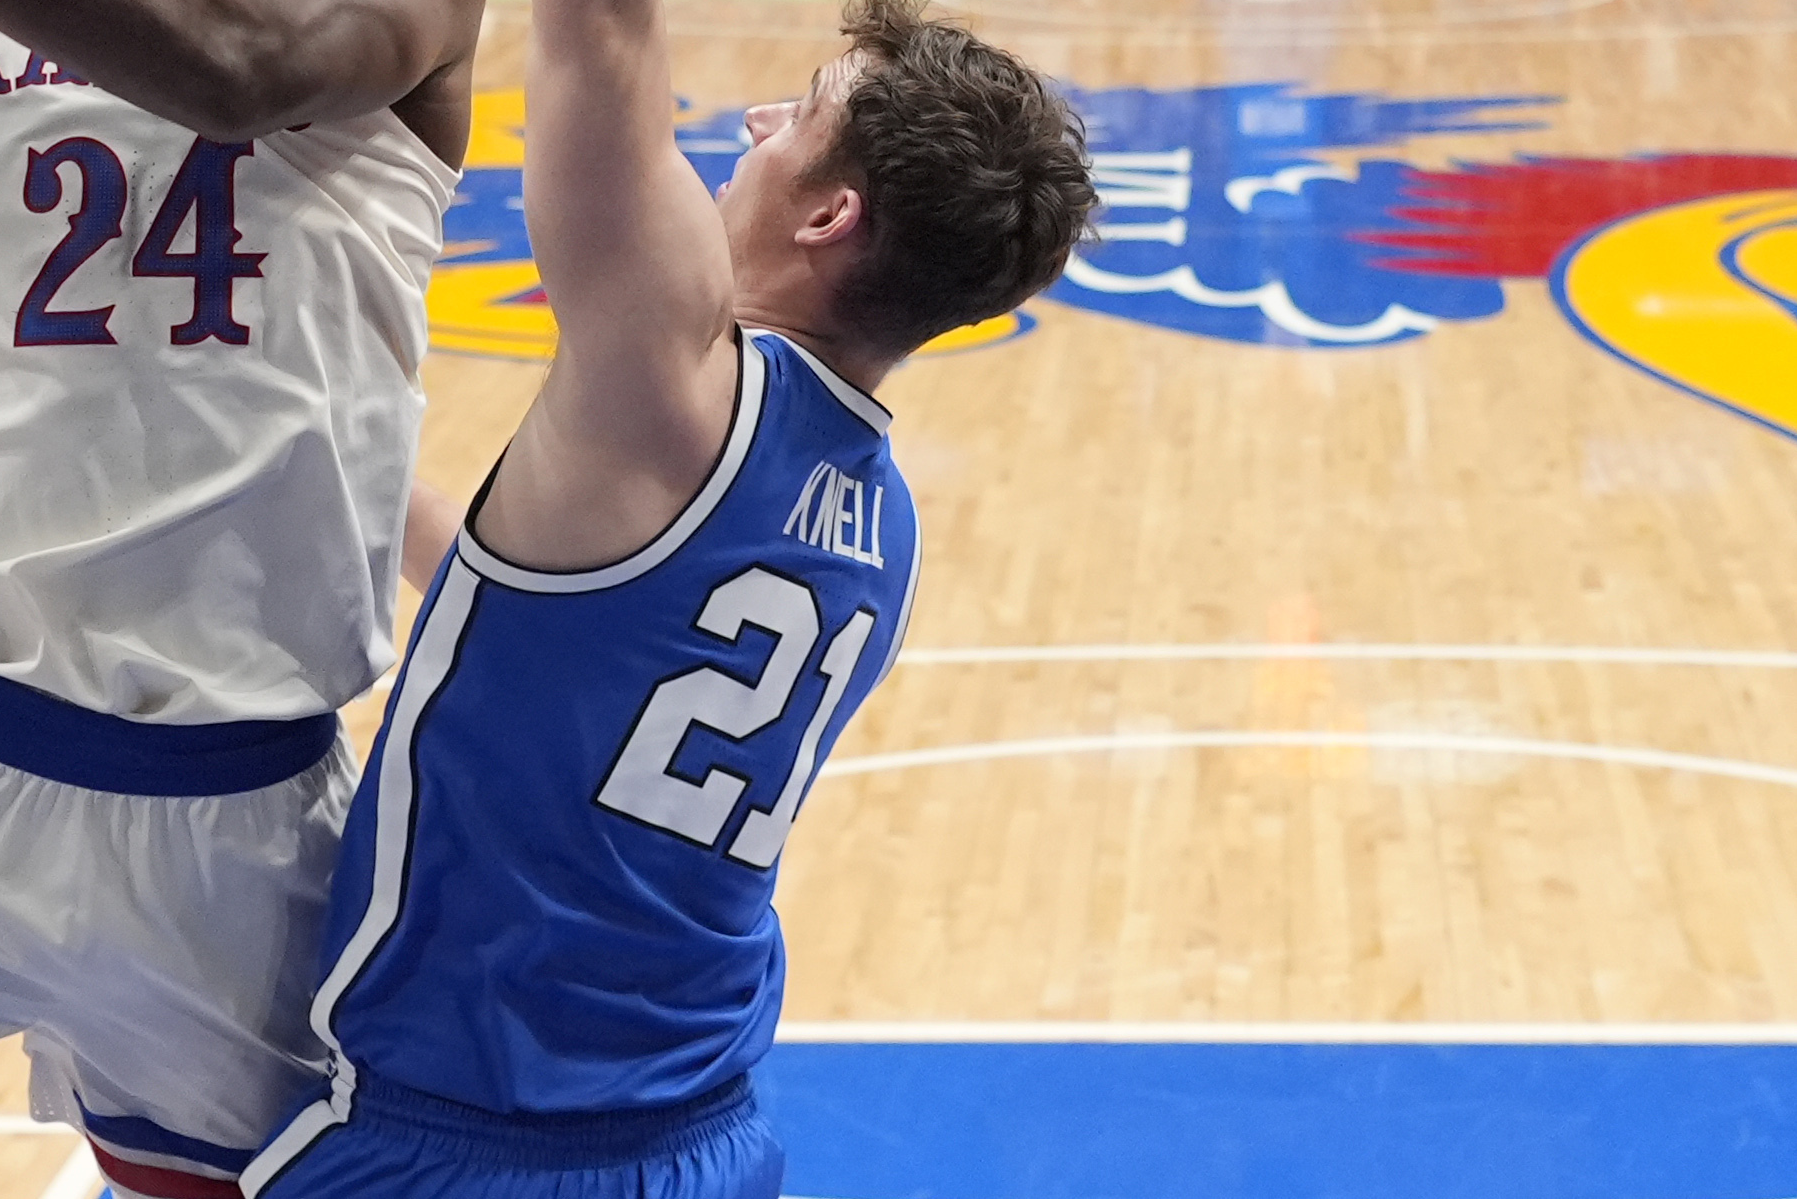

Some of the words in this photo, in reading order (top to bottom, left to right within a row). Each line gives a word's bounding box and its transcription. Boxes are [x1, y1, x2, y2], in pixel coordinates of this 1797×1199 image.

[14, 136, 269, 347] 24
[781, 459, 885, 570] KNELL
[594, 564, 874, 869] 21
